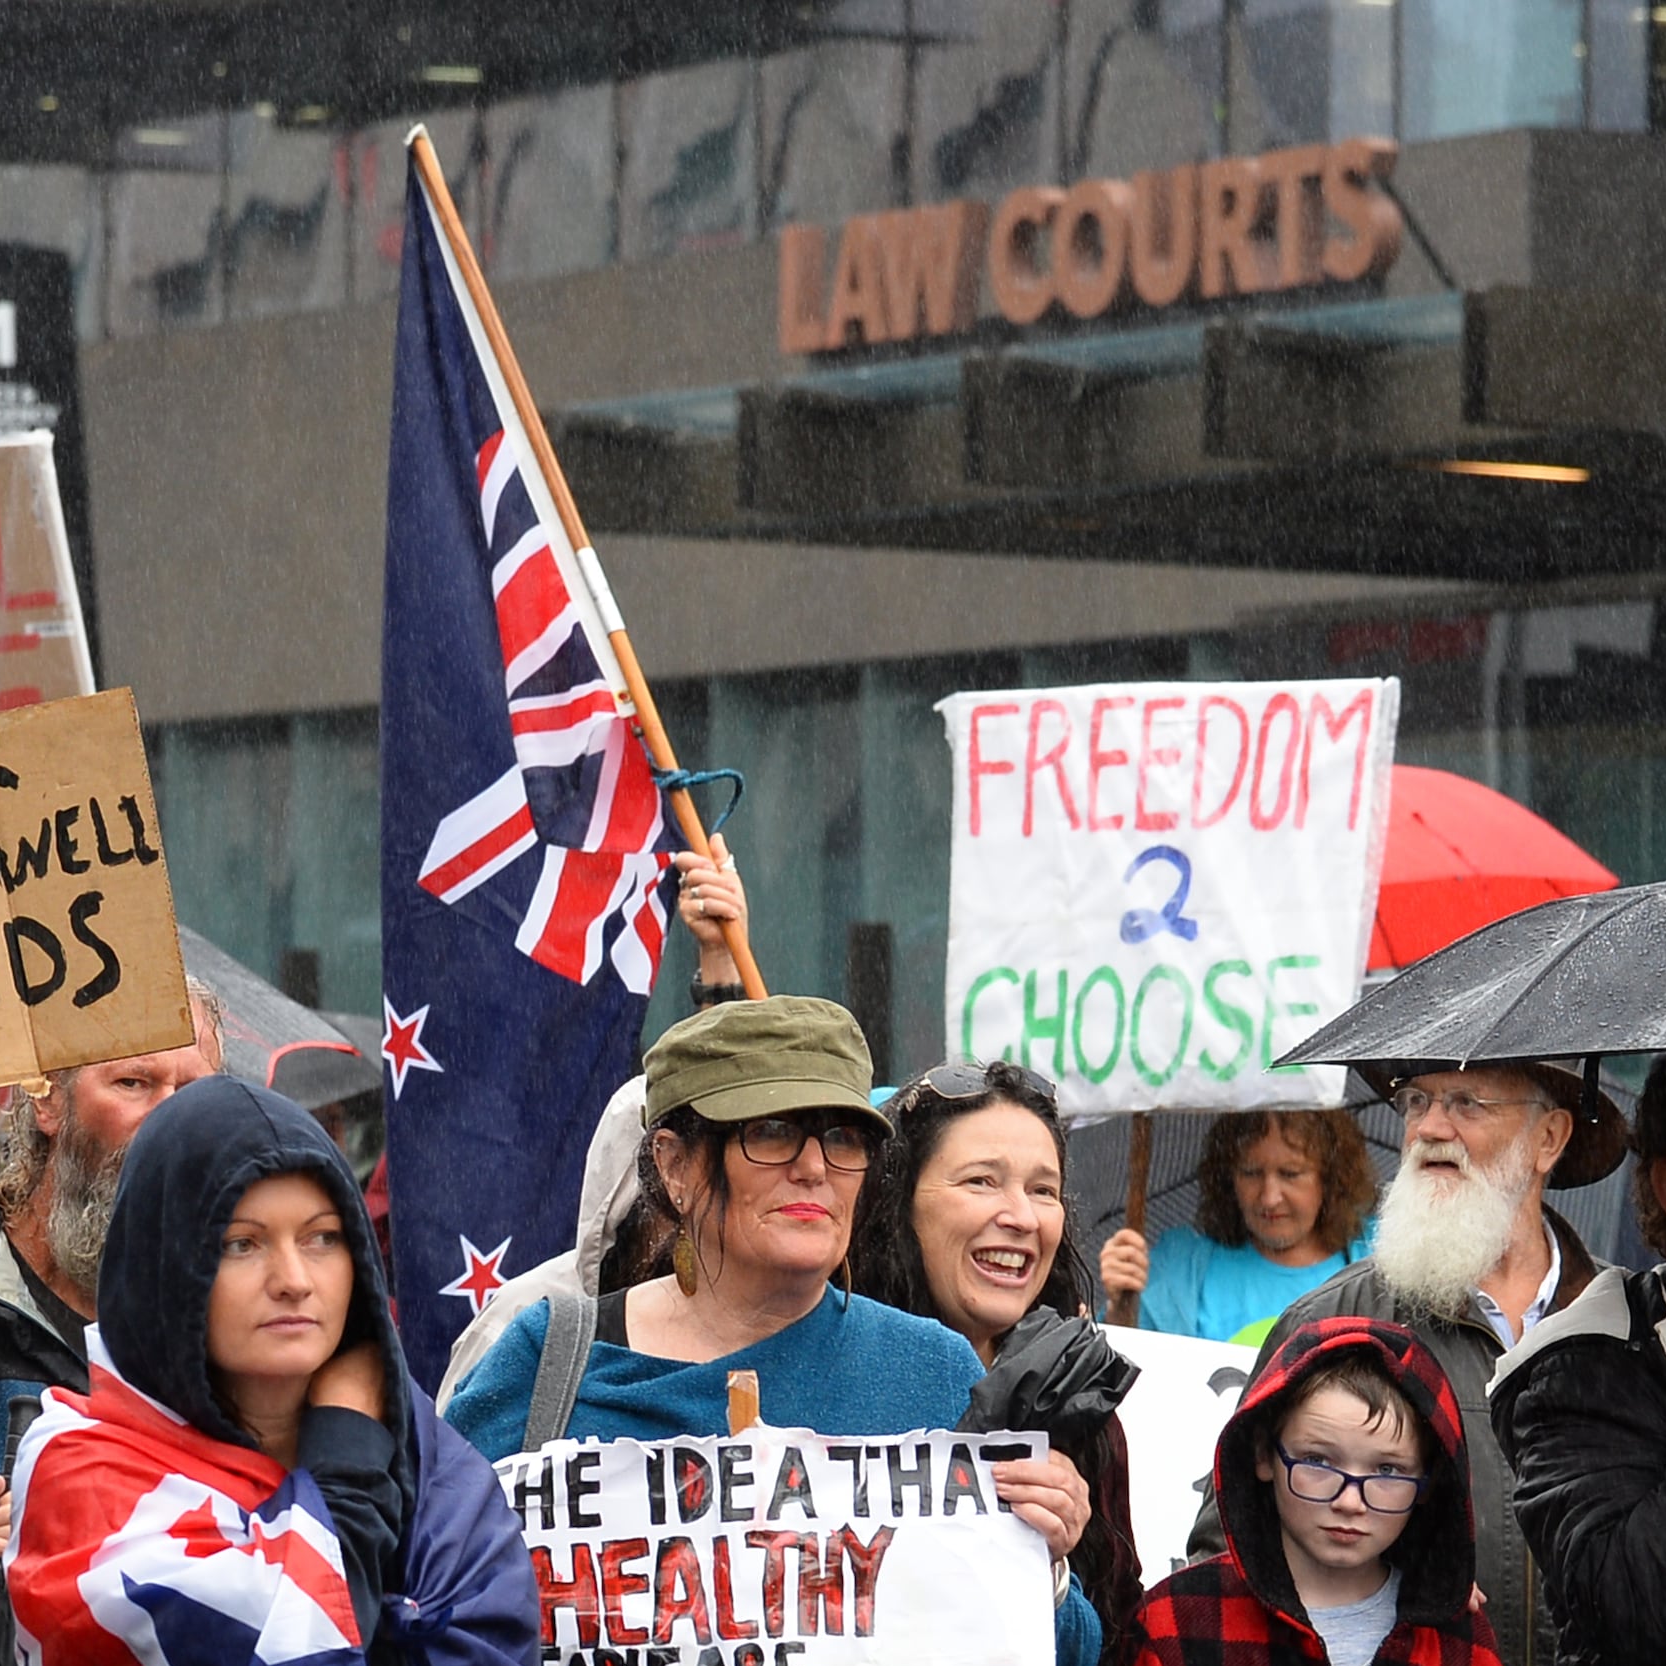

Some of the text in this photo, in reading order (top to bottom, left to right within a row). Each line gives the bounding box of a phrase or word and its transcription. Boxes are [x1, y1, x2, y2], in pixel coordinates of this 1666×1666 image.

[779, 135, 1405, 353] LAW COURTS
[968, 687, 1375, 838] FREEDOM
[1119, 844, 1199, 946] 2
[960, 955, 1323, 1088] CHOOSE
[648, 1444, 818, 1529] IDEA
[827, 1442, 1033, 1518] THAT
[534, 1522, 899, 1649] HEALTHY
